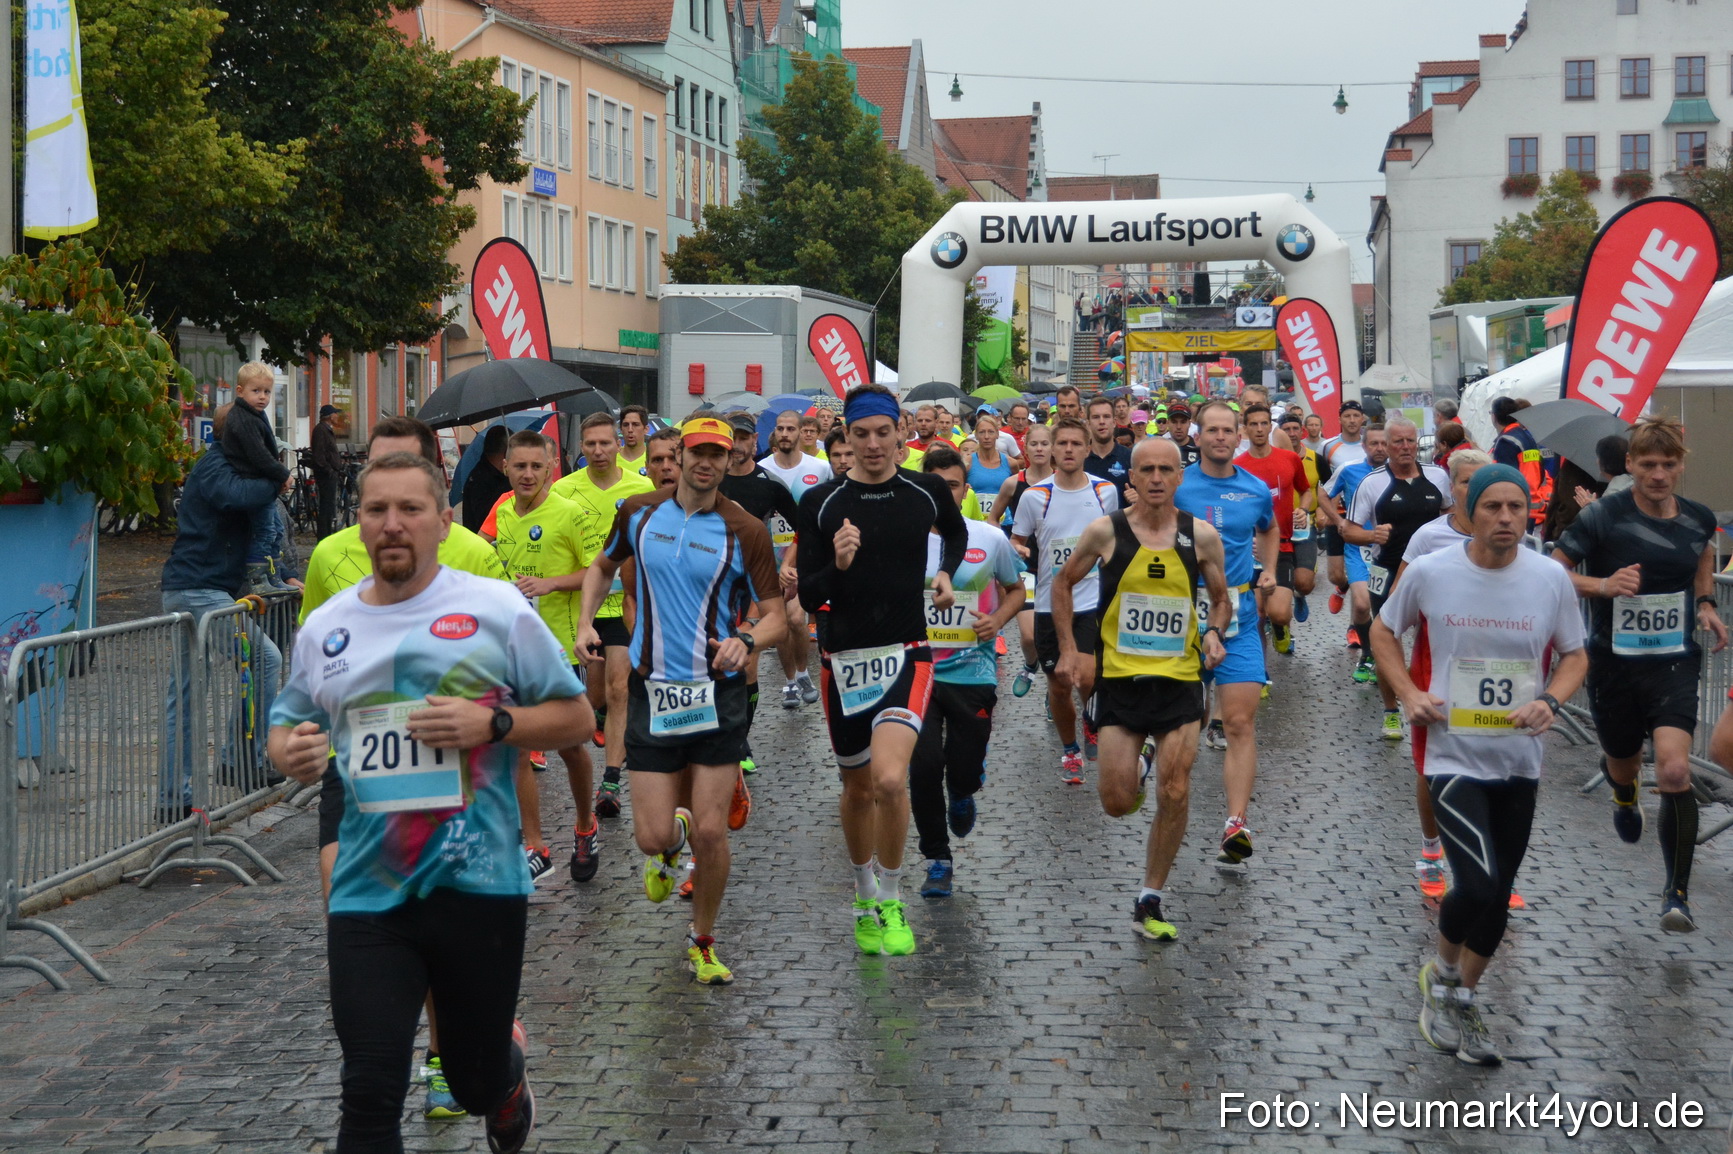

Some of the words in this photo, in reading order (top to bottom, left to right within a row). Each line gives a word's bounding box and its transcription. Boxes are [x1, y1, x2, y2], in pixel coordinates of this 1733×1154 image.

[980, 215, 1077, 243] BMW
[1087, 211, 1262, 246] Laufsport
[1281, 224, 1312, 238] BMW
[934, 233, 963, 247] BMW
[1578, 228, 1697, 417] REWE
[1185, 335, 1219, 347] ZIEL
[203, 425, 213, 439] P
[861, 491, 895, 500] uhlsport
[1053, 548, 1076, 565] 28
[928, 605, 965, 625] 307
[1126, 609, 1183, 634] 3096
[1443, 614, 1536, 631] Kaiserwinkl
[1622, 608, 1678, 631] 2666
[437, 620, 473, 633] Hervis
[933, 631, 959, 639] Karam
[1639, 637, 1661, 646] Maik
[323, 659, 348, 674] PARTL
[842, 656, 898, 688] 2790
[655, 686, 707, 712] 2684
[1479, 678, 1513, 706] 63
[663, 713, 704, 728] Sebastian
